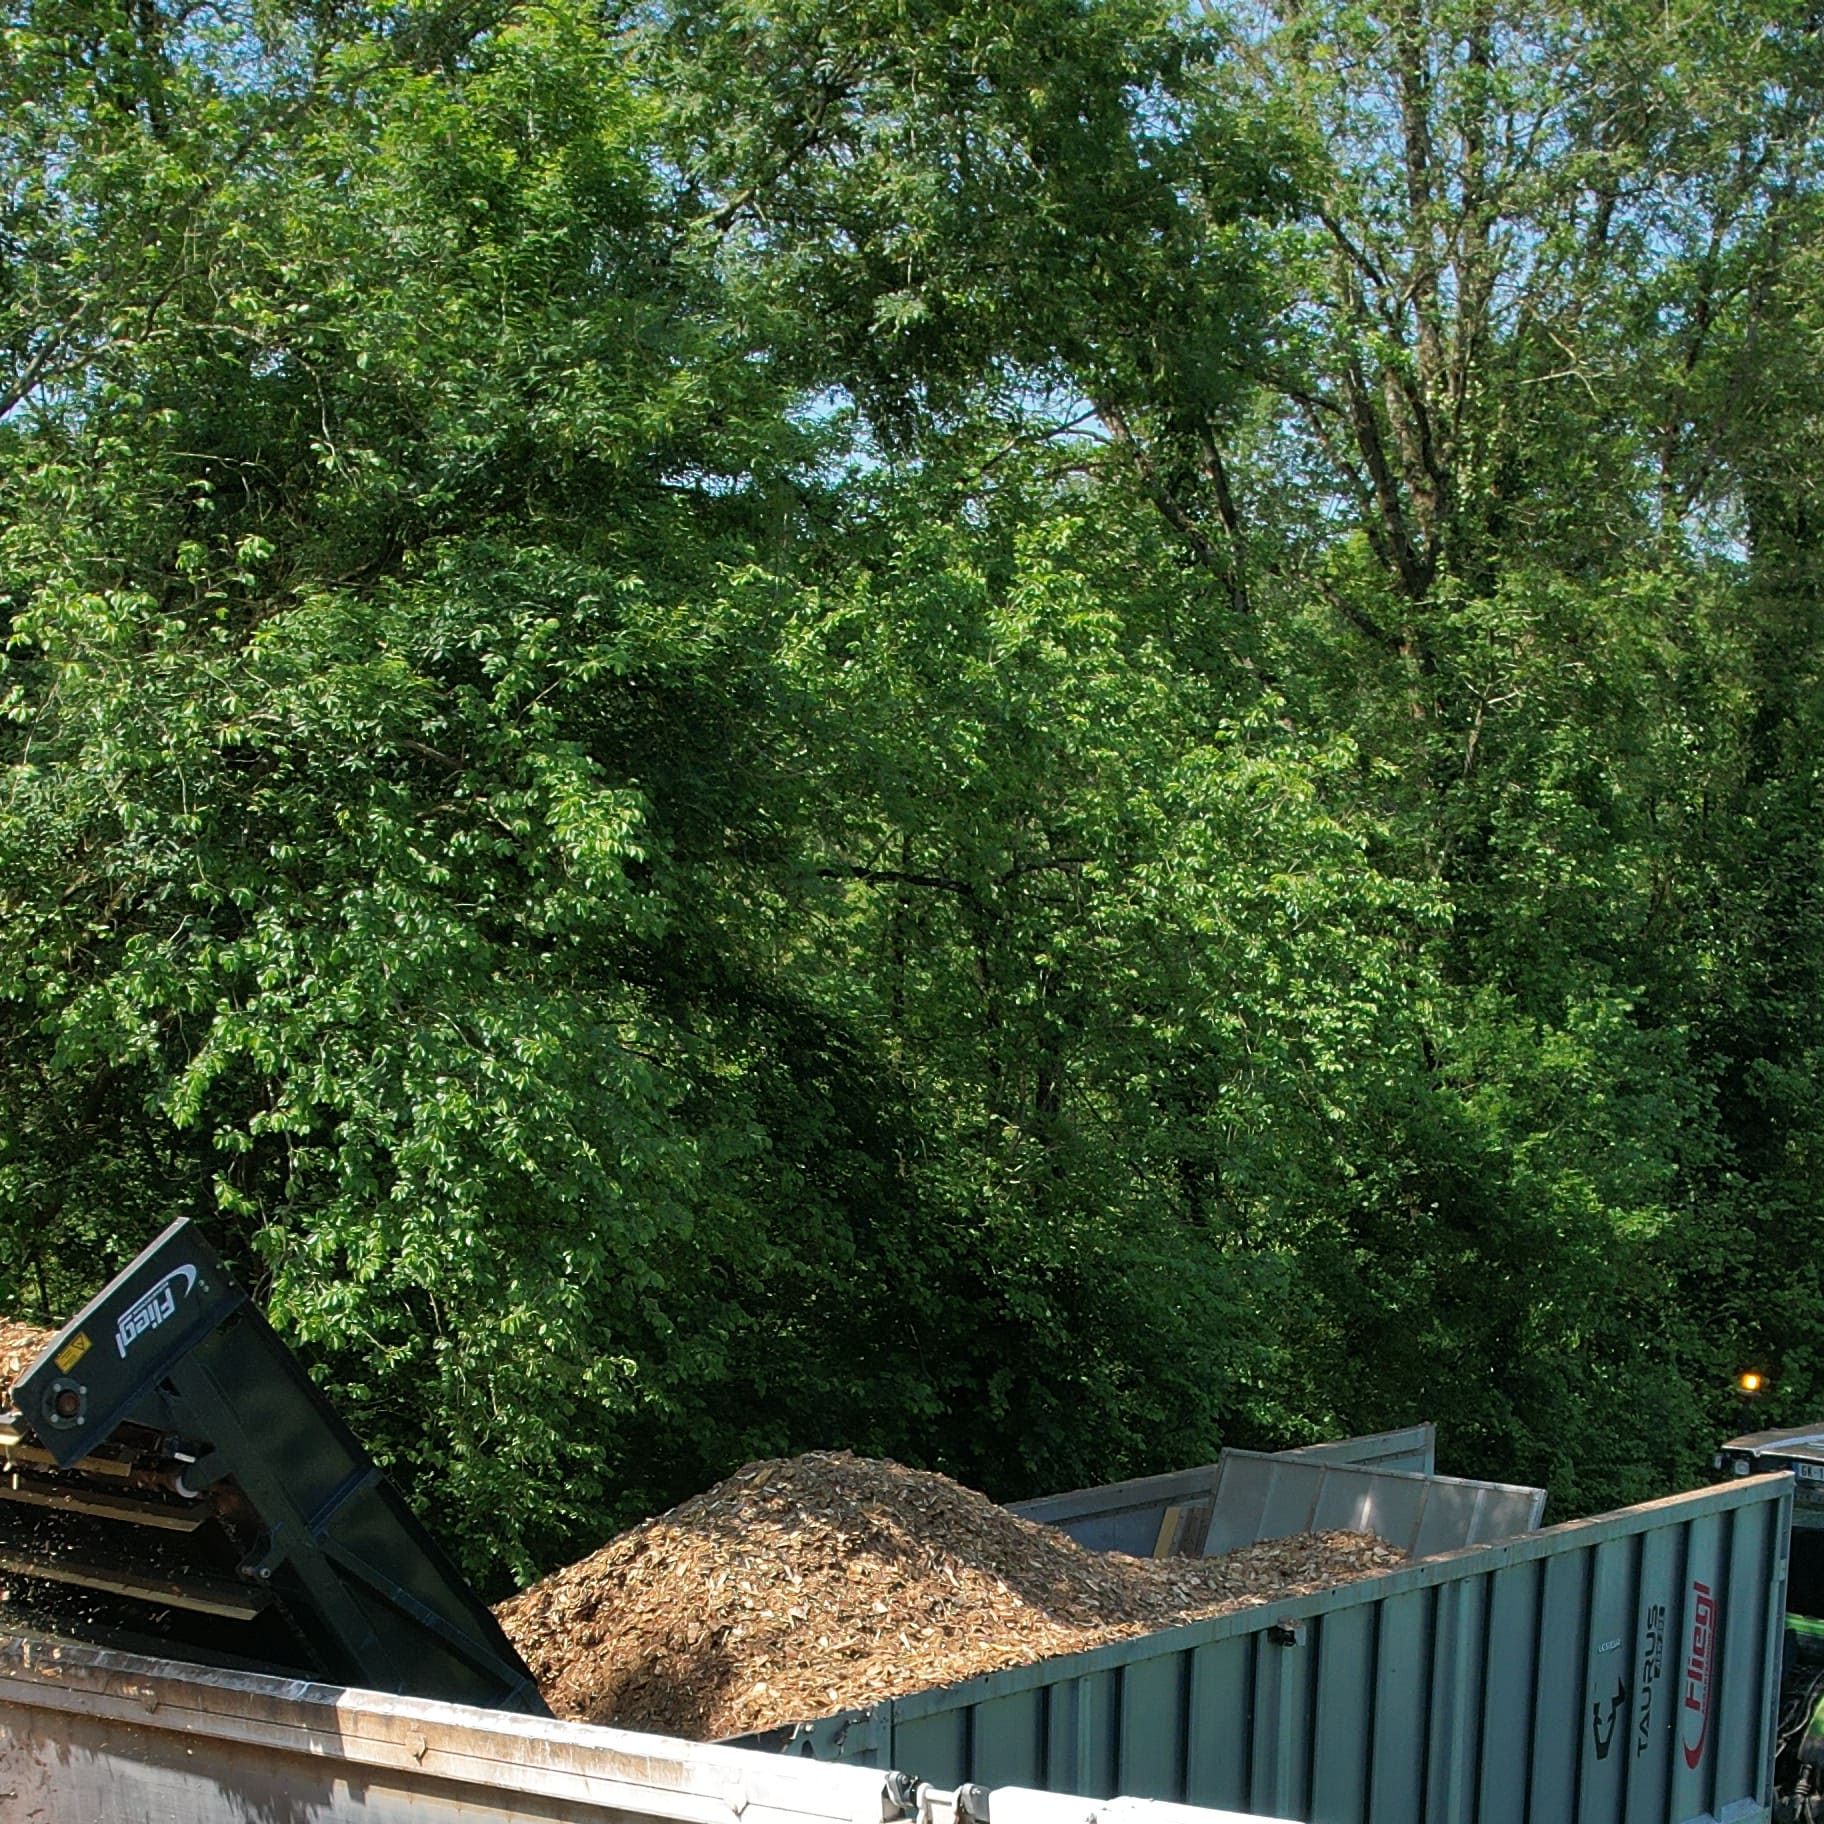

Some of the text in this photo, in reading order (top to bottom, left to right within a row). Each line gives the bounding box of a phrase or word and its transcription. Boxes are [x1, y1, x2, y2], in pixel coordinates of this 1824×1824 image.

[115, 1286, 176, 1360] Fliegl
[1637, 1604, 1659, 1758] TAURUS
[1685, 1581, 1717, 1712] Fliegl
